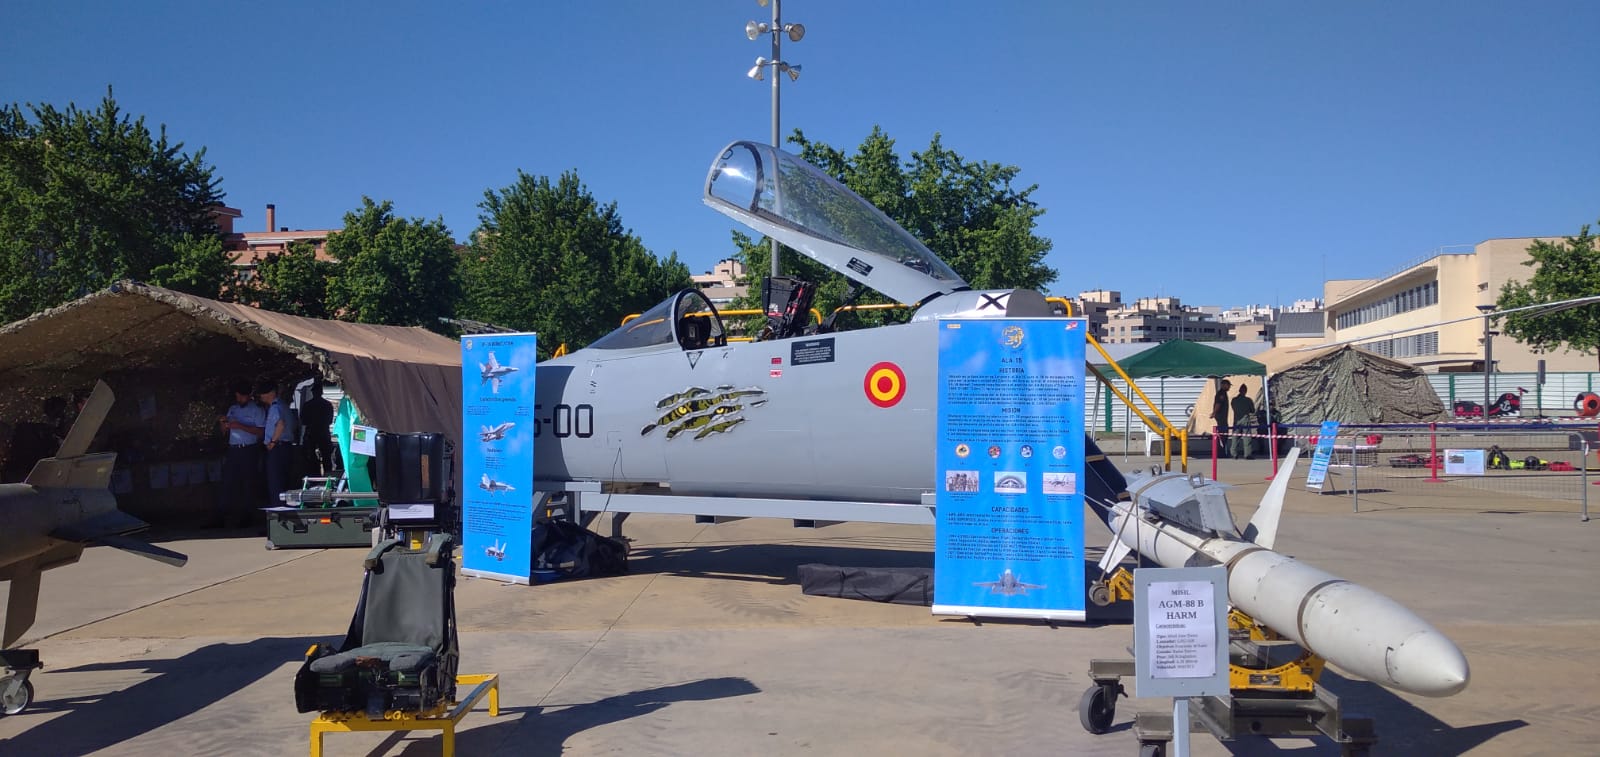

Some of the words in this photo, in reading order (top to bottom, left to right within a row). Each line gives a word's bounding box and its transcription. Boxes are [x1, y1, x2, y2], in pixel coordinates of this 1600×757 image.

[1158, 600, 1196, 608] AGM-88
[1198, 599, 1205, 607] B
[1167, 611, 1197, 619] HARM
